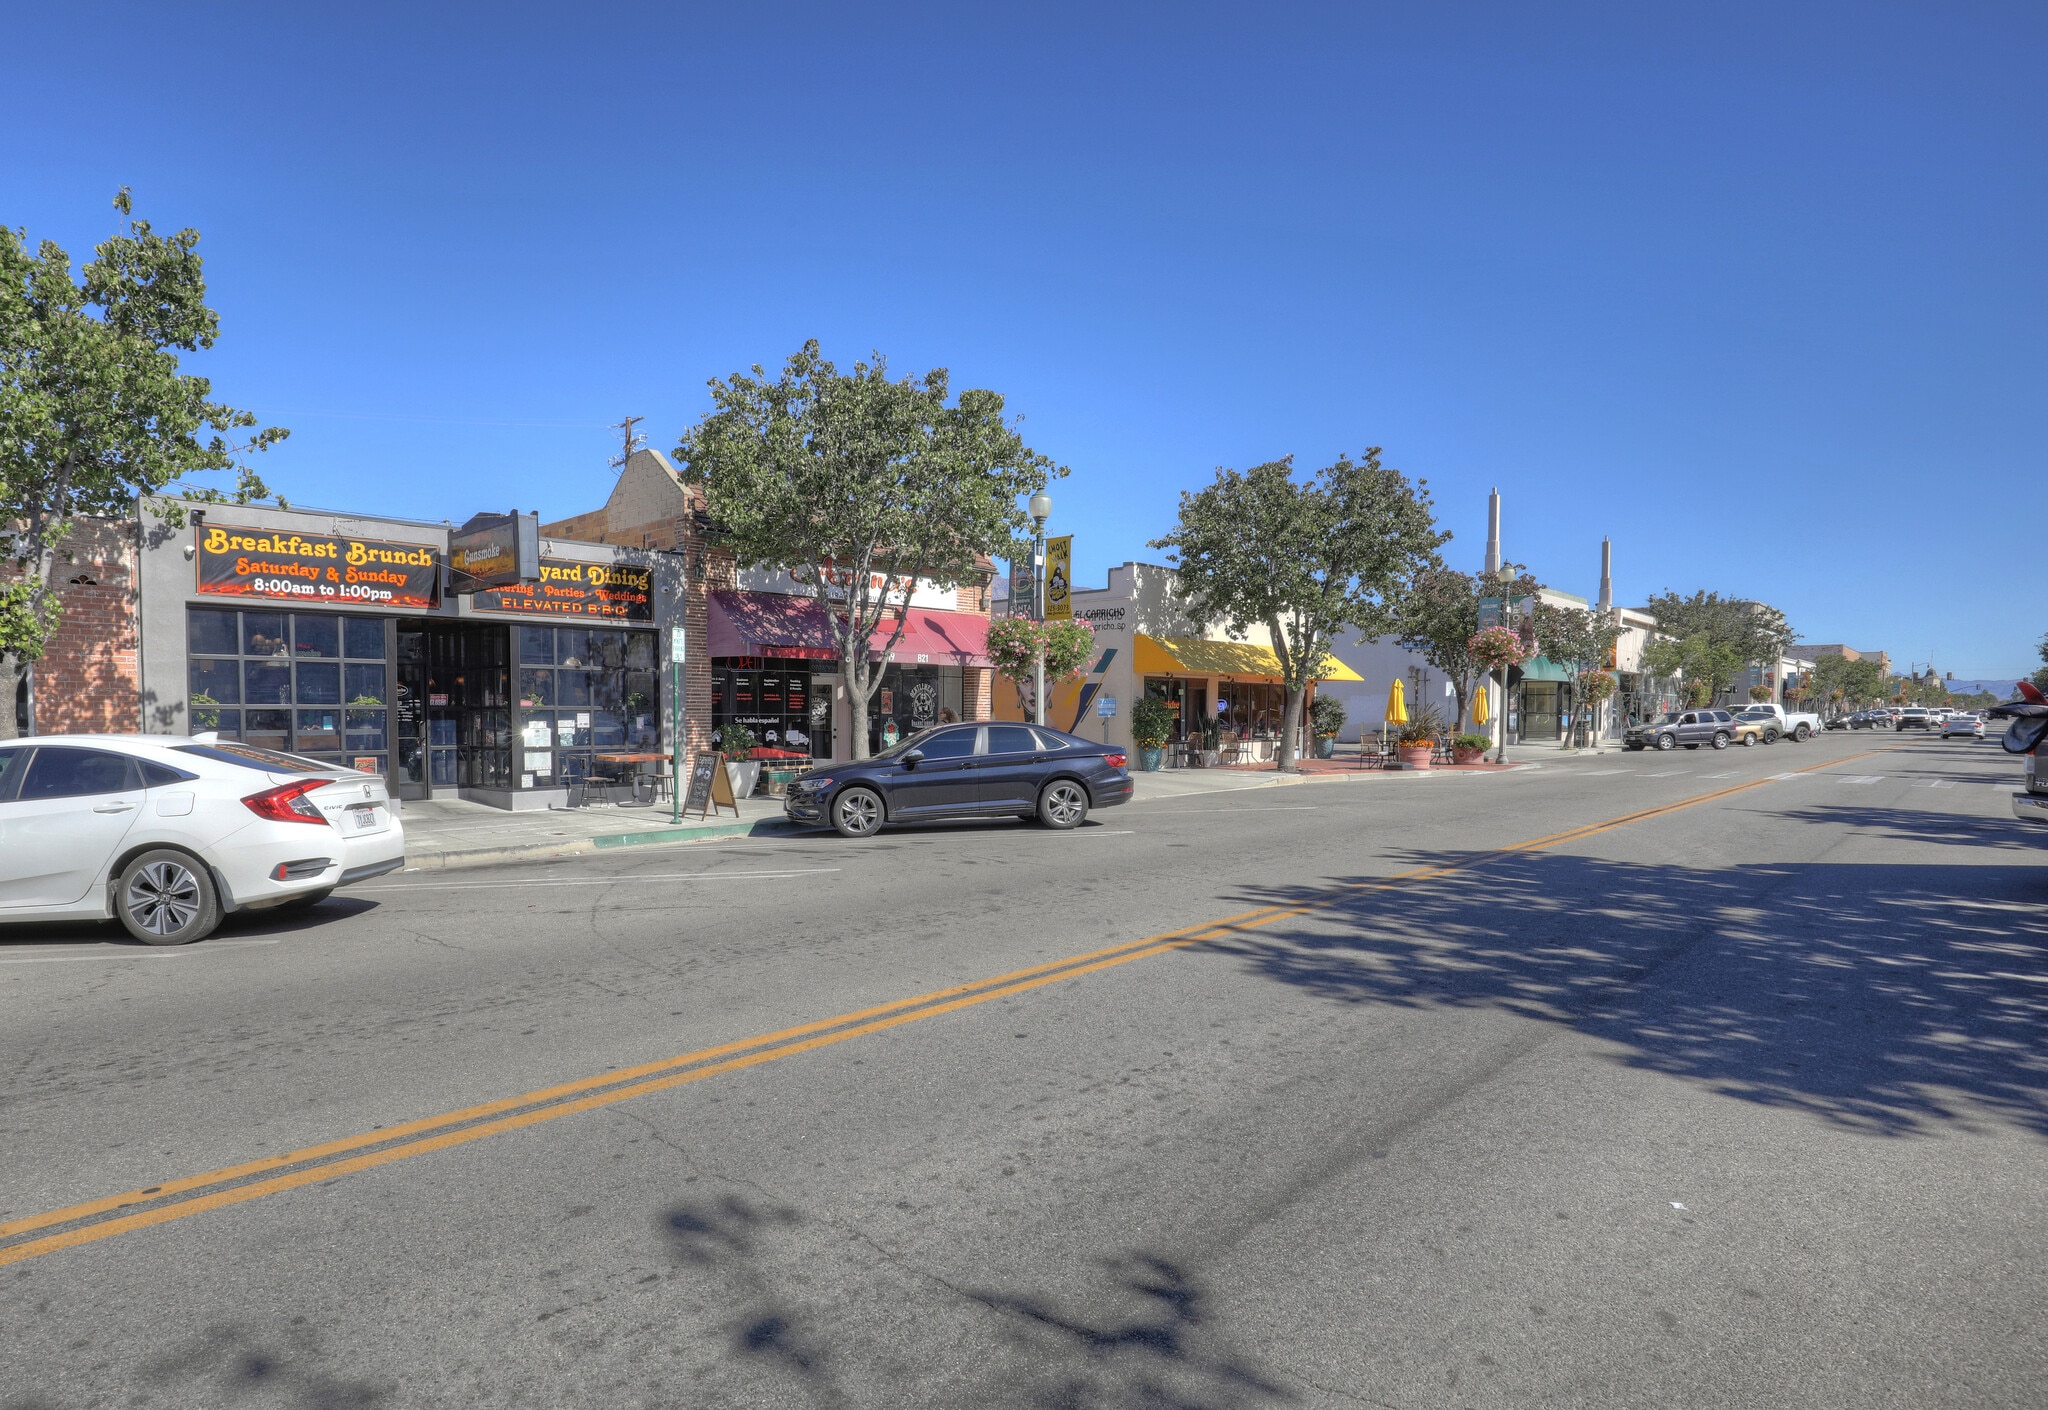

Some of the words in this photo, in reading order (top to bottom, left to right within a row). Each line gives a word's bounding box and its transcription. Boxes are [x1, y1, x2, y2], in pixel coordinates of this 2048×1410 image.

[203, 528, 337, 558] Breakfast
[345, 542, 433, 567] Brunch
[463, 543, 500, 566] Gunsmoke
[235, 557, 320, 581] Saturday
[325, 566, 340, 583] &
[344, 566, 408, 586] Sunday
[539, 565, 582, 583] yard
[587, 565, 650, 590] Dining
[253, 578, 315, 595] 8:00am
[319, 584, 335, 596] to
[339, 584, 392, 600] 1:00pm
[544, 585, 585, 598] Parties
[595, 589, 647, 605] Weddings
[502, 597, 582, 613] ELEVATED
[1085, 607, 1125, 620] CAPRICHO
[1512, 602, 1521, 632] PLORE
[917, 653, 929, 662] 821
[758, 717, 780, 725] español
